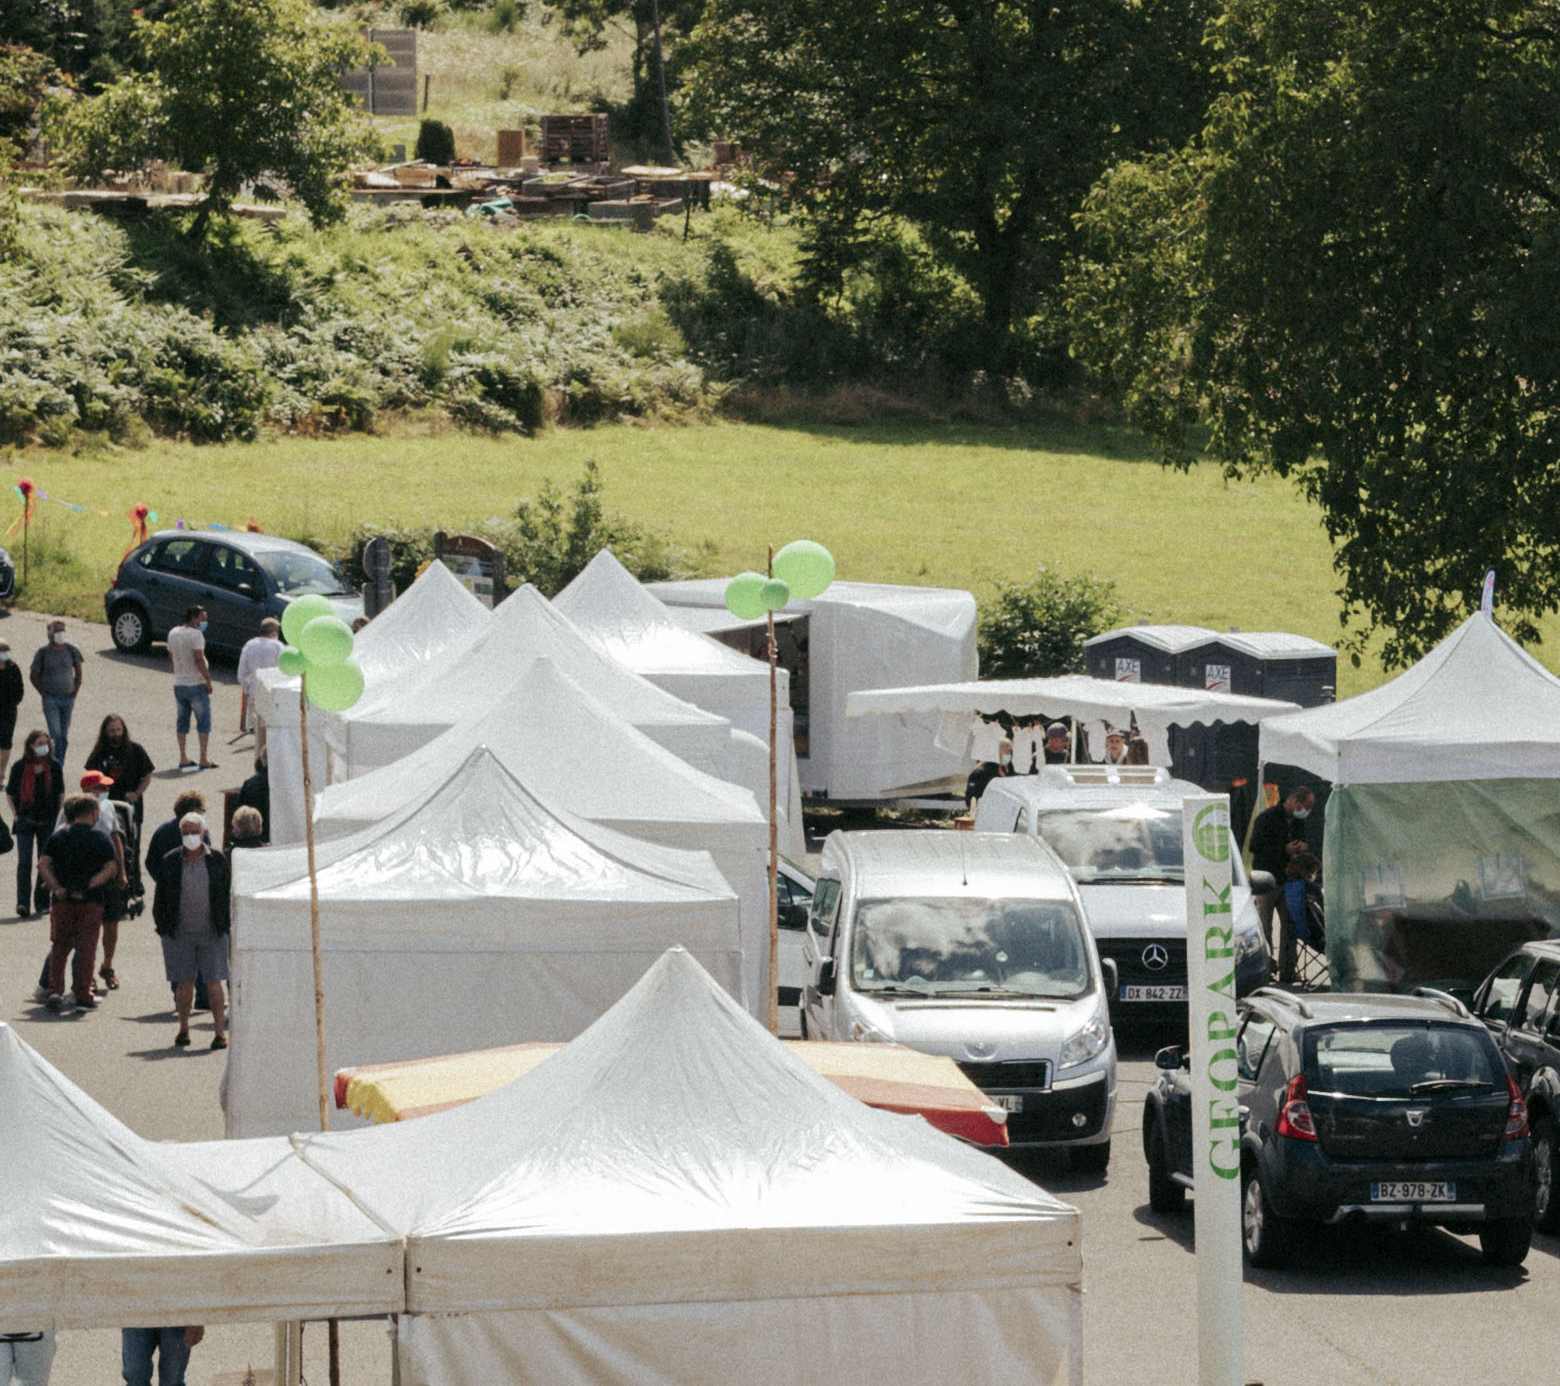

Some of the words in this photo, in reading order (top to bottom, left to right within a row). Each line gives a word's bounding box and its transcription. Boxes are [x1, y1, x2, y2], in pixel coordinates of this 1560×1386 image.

[1117, 659, 1138, 673] AXE
[1207, 666, 1229, 679] AXE
[1203, 877, 1241, 1180] GEOPARK
